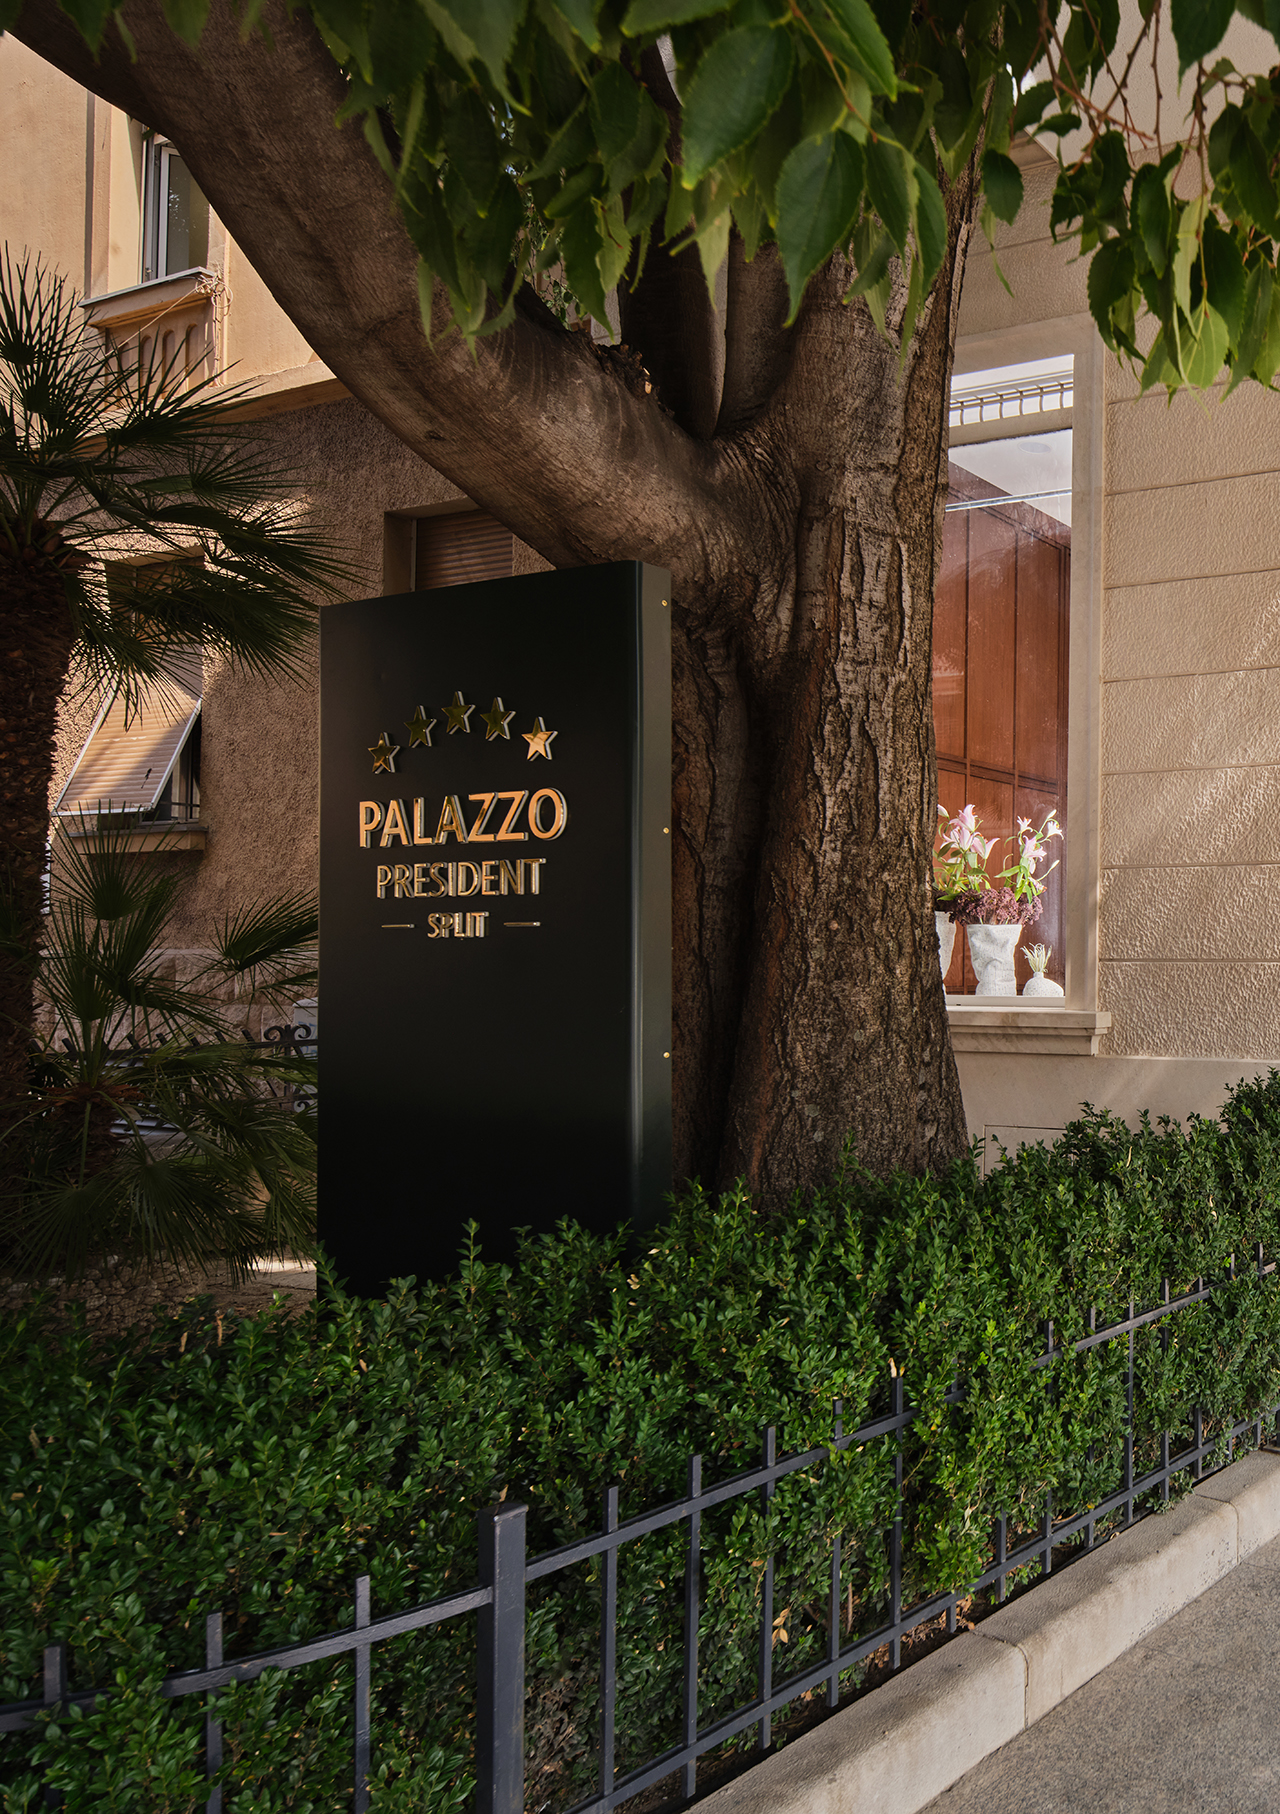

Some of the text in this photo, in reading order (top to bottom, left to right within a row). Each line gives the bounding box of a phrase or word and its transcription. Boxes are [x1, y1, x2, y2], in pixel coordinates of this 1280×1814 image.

[359, 788, 567, 847] PALAZZO
[377, 858, 546, 898] PRESIDENT
[427, 912, 489, 938] SPLIT
